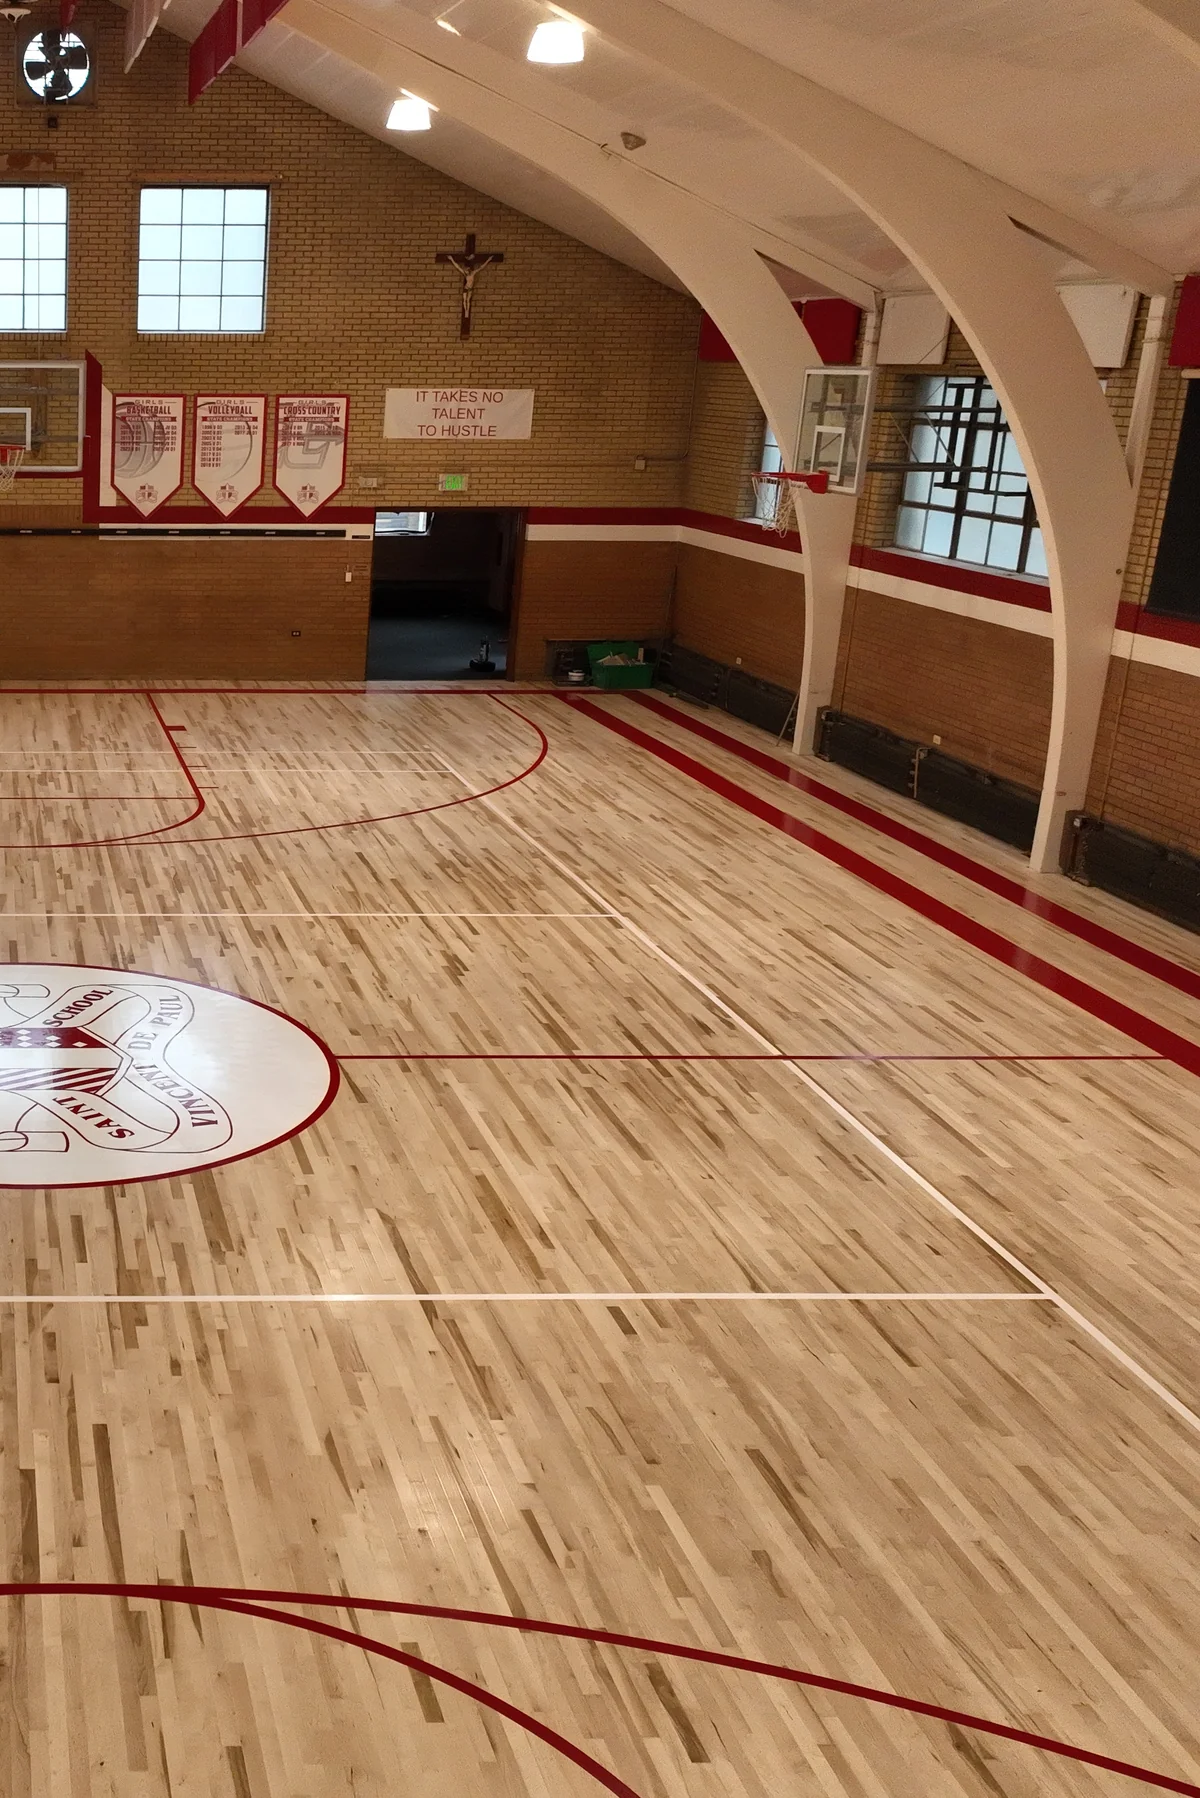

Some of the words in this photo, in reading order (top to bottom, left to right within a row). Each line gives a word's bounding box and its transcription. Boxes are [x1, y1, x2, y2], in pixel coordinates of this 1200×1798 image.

[416, 391, 428, 402] IT
[432, 391, 478, 403] TAKES
[482, 392, 503, 403] NO
[127, 406, 171, 414] BASKETBALL
[208, 406, 252, 414] VOLLEYBALL
[284, 406, 306, 414] CROSS
[308, 406, 340, 415] COUNTRY
[432, 408, 485, 419] TALENT
[417, 425, 436, 436] TO
[442, 425, 497, 437] HUSTLE
[43, 989, 114, 1027] SCHOOL
[151, 995, 183, 1027] PAUL
[127, 1031, 158, 1050] DE
[132, 1063, 218, 1127] VINCENT
[52, 1096, 135, 1139] SAINT
